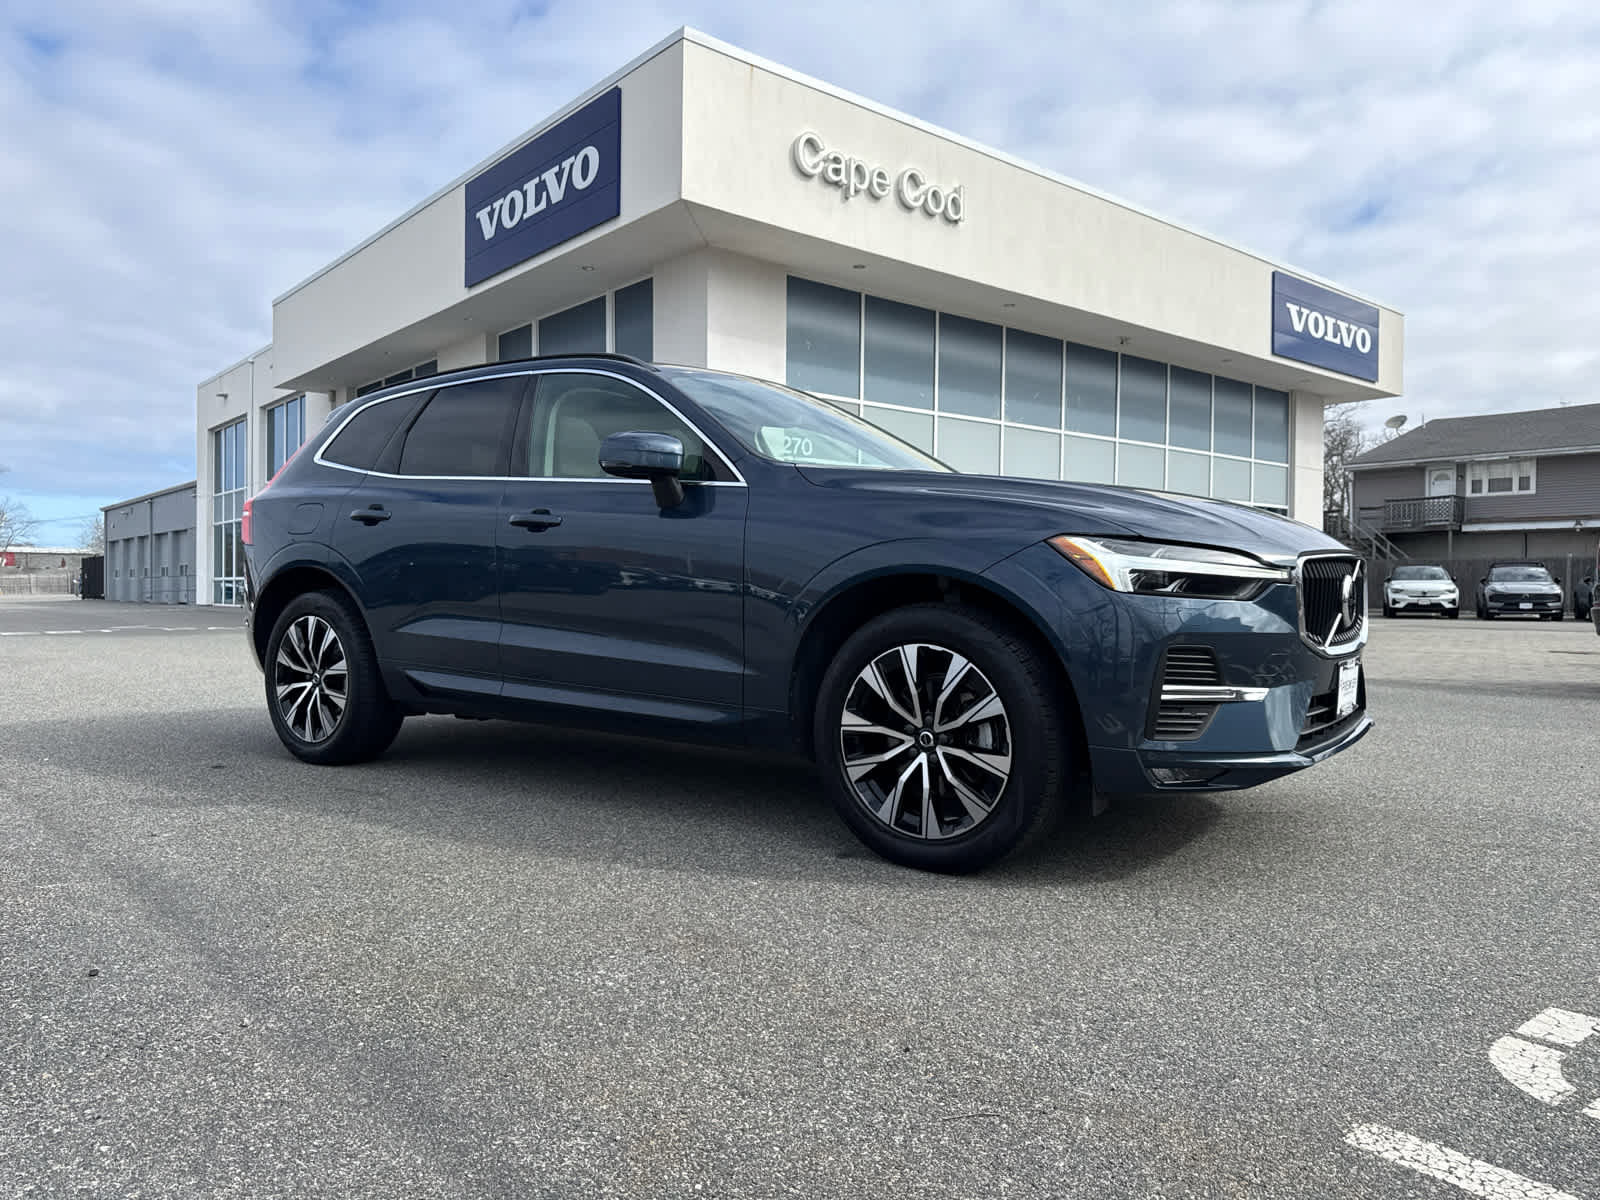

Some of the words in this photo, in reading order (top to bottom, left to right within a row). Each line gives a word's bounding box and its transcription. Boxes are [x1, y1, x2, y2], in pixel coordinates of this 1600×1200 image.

[475, 145, 599, 240] VOLVO
[792, 131, 890, 200] Cape
[899, 168, 965, 223] Cod
[1285, 302, 1372, 354] VOLVO
